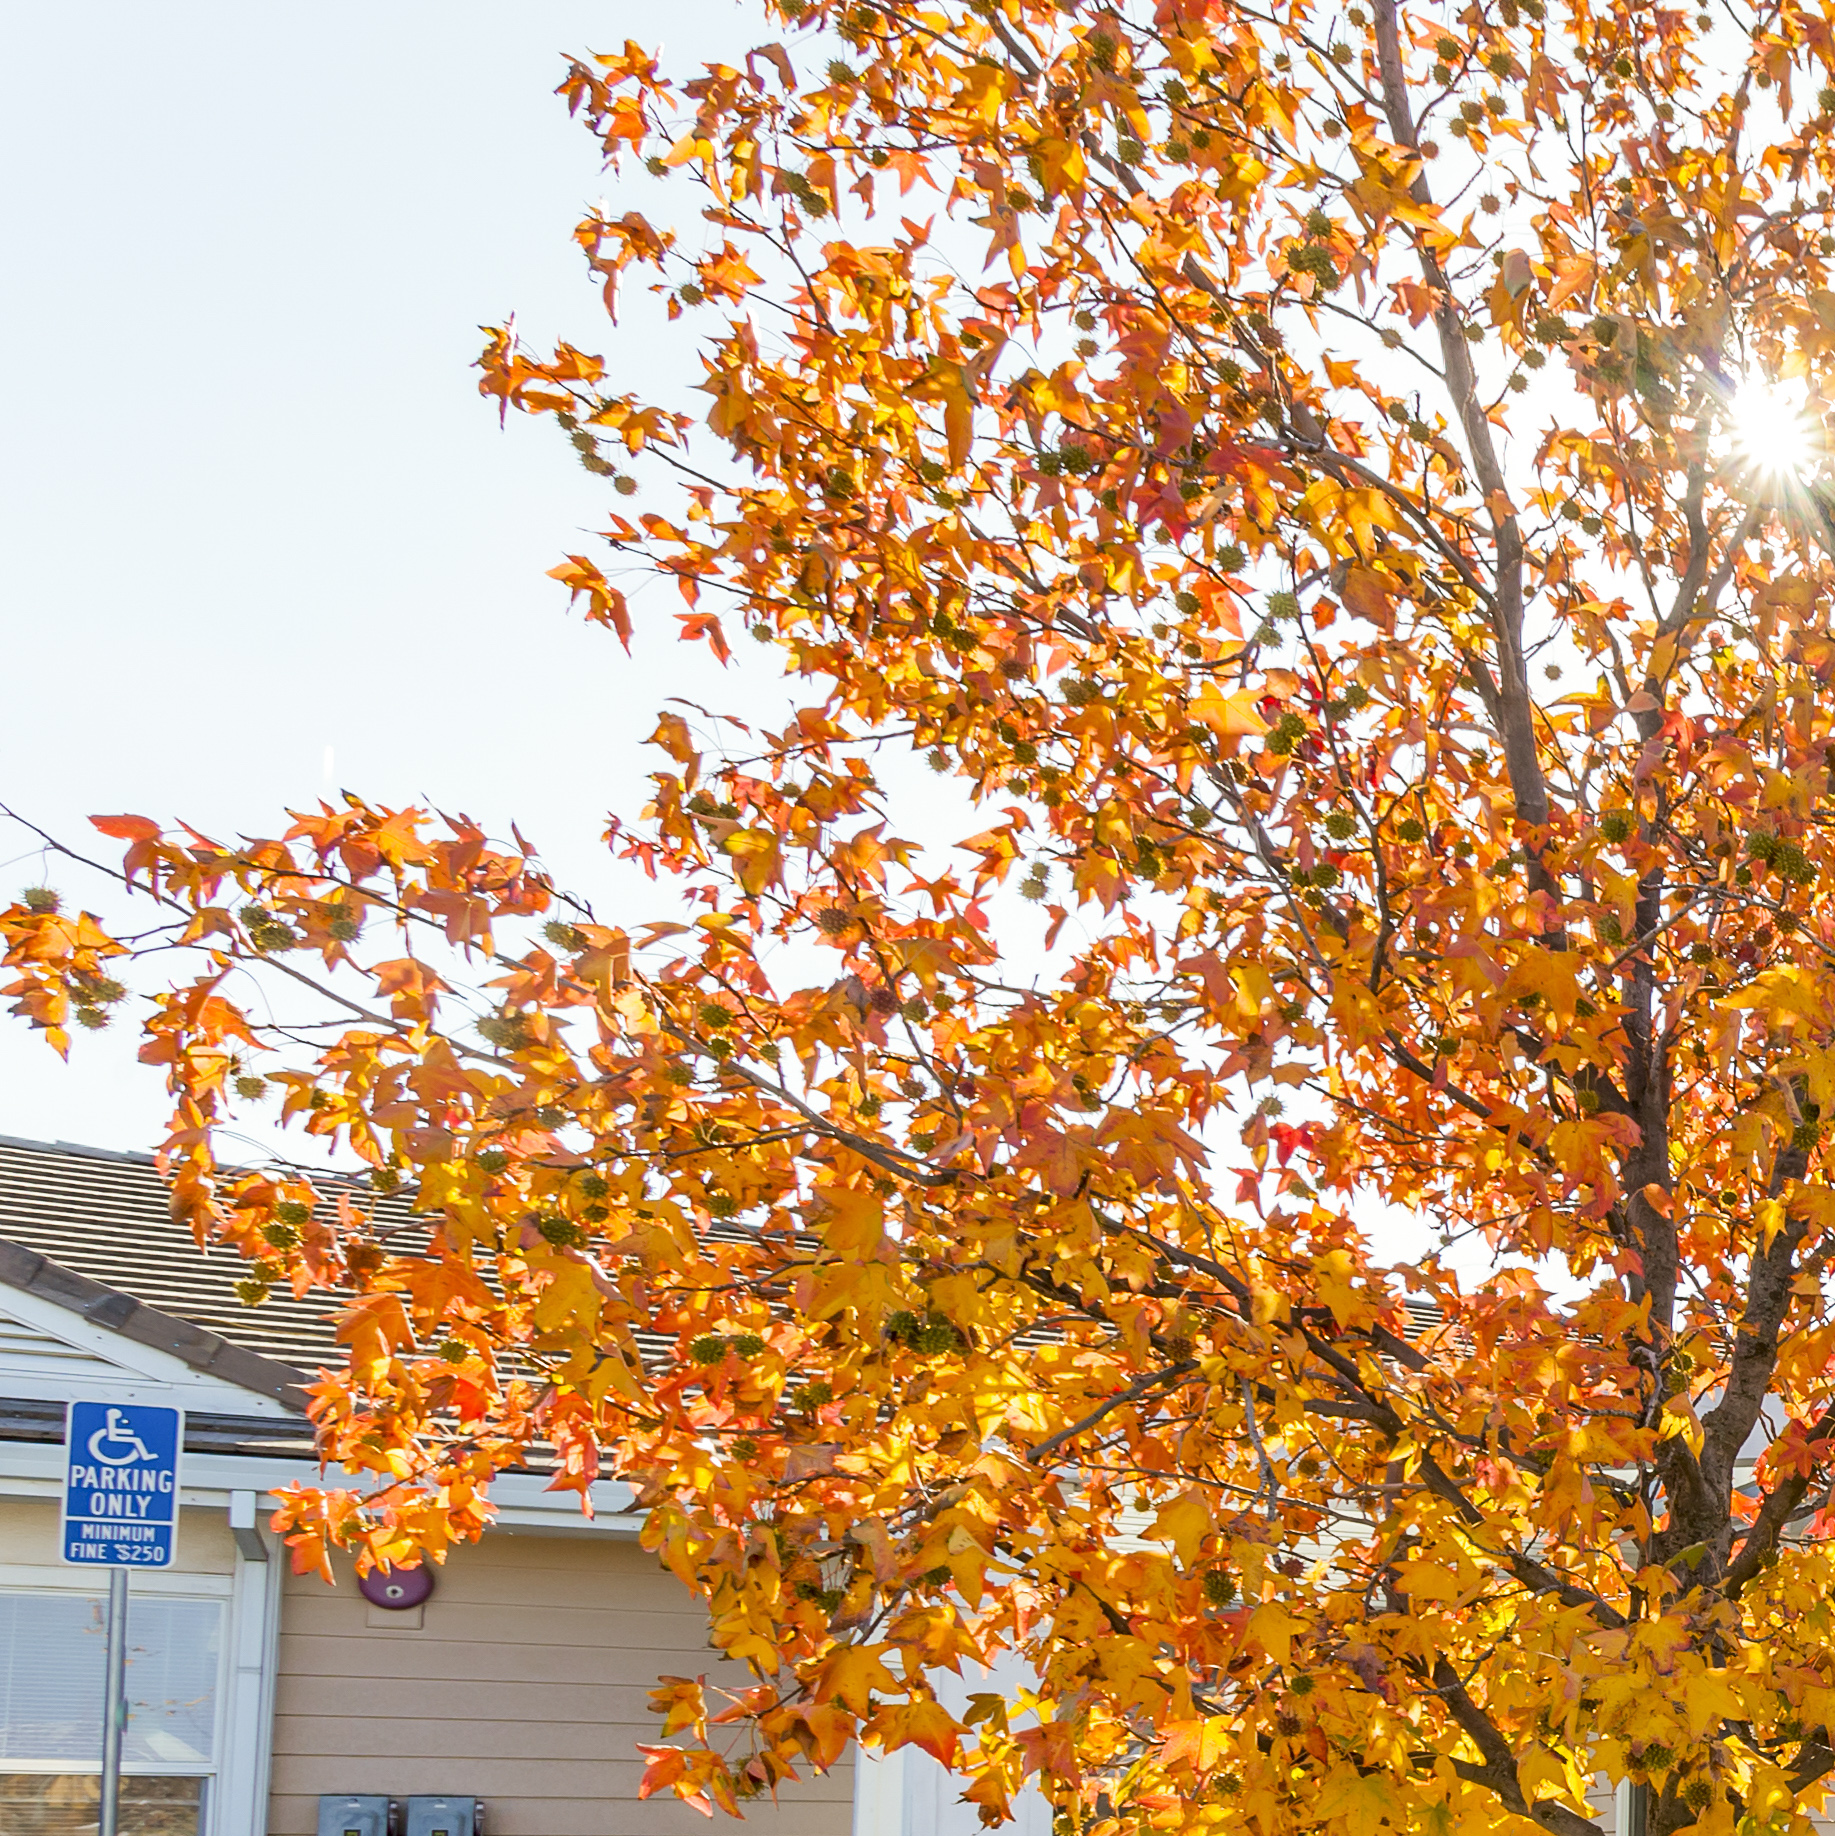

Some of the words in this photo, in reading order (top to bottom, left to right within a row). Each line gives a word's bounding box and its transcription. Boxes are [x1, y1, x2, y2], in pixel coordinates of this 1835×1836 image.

[71, 1465, 173, 1493] PARKING
[90, 1492, 152, 1518] ONLY
[81, 1524, 155, 1542] MINIMUM
[70, 1542, 108, 1559] FINE
[113, 1544, 165, 1562] $250
